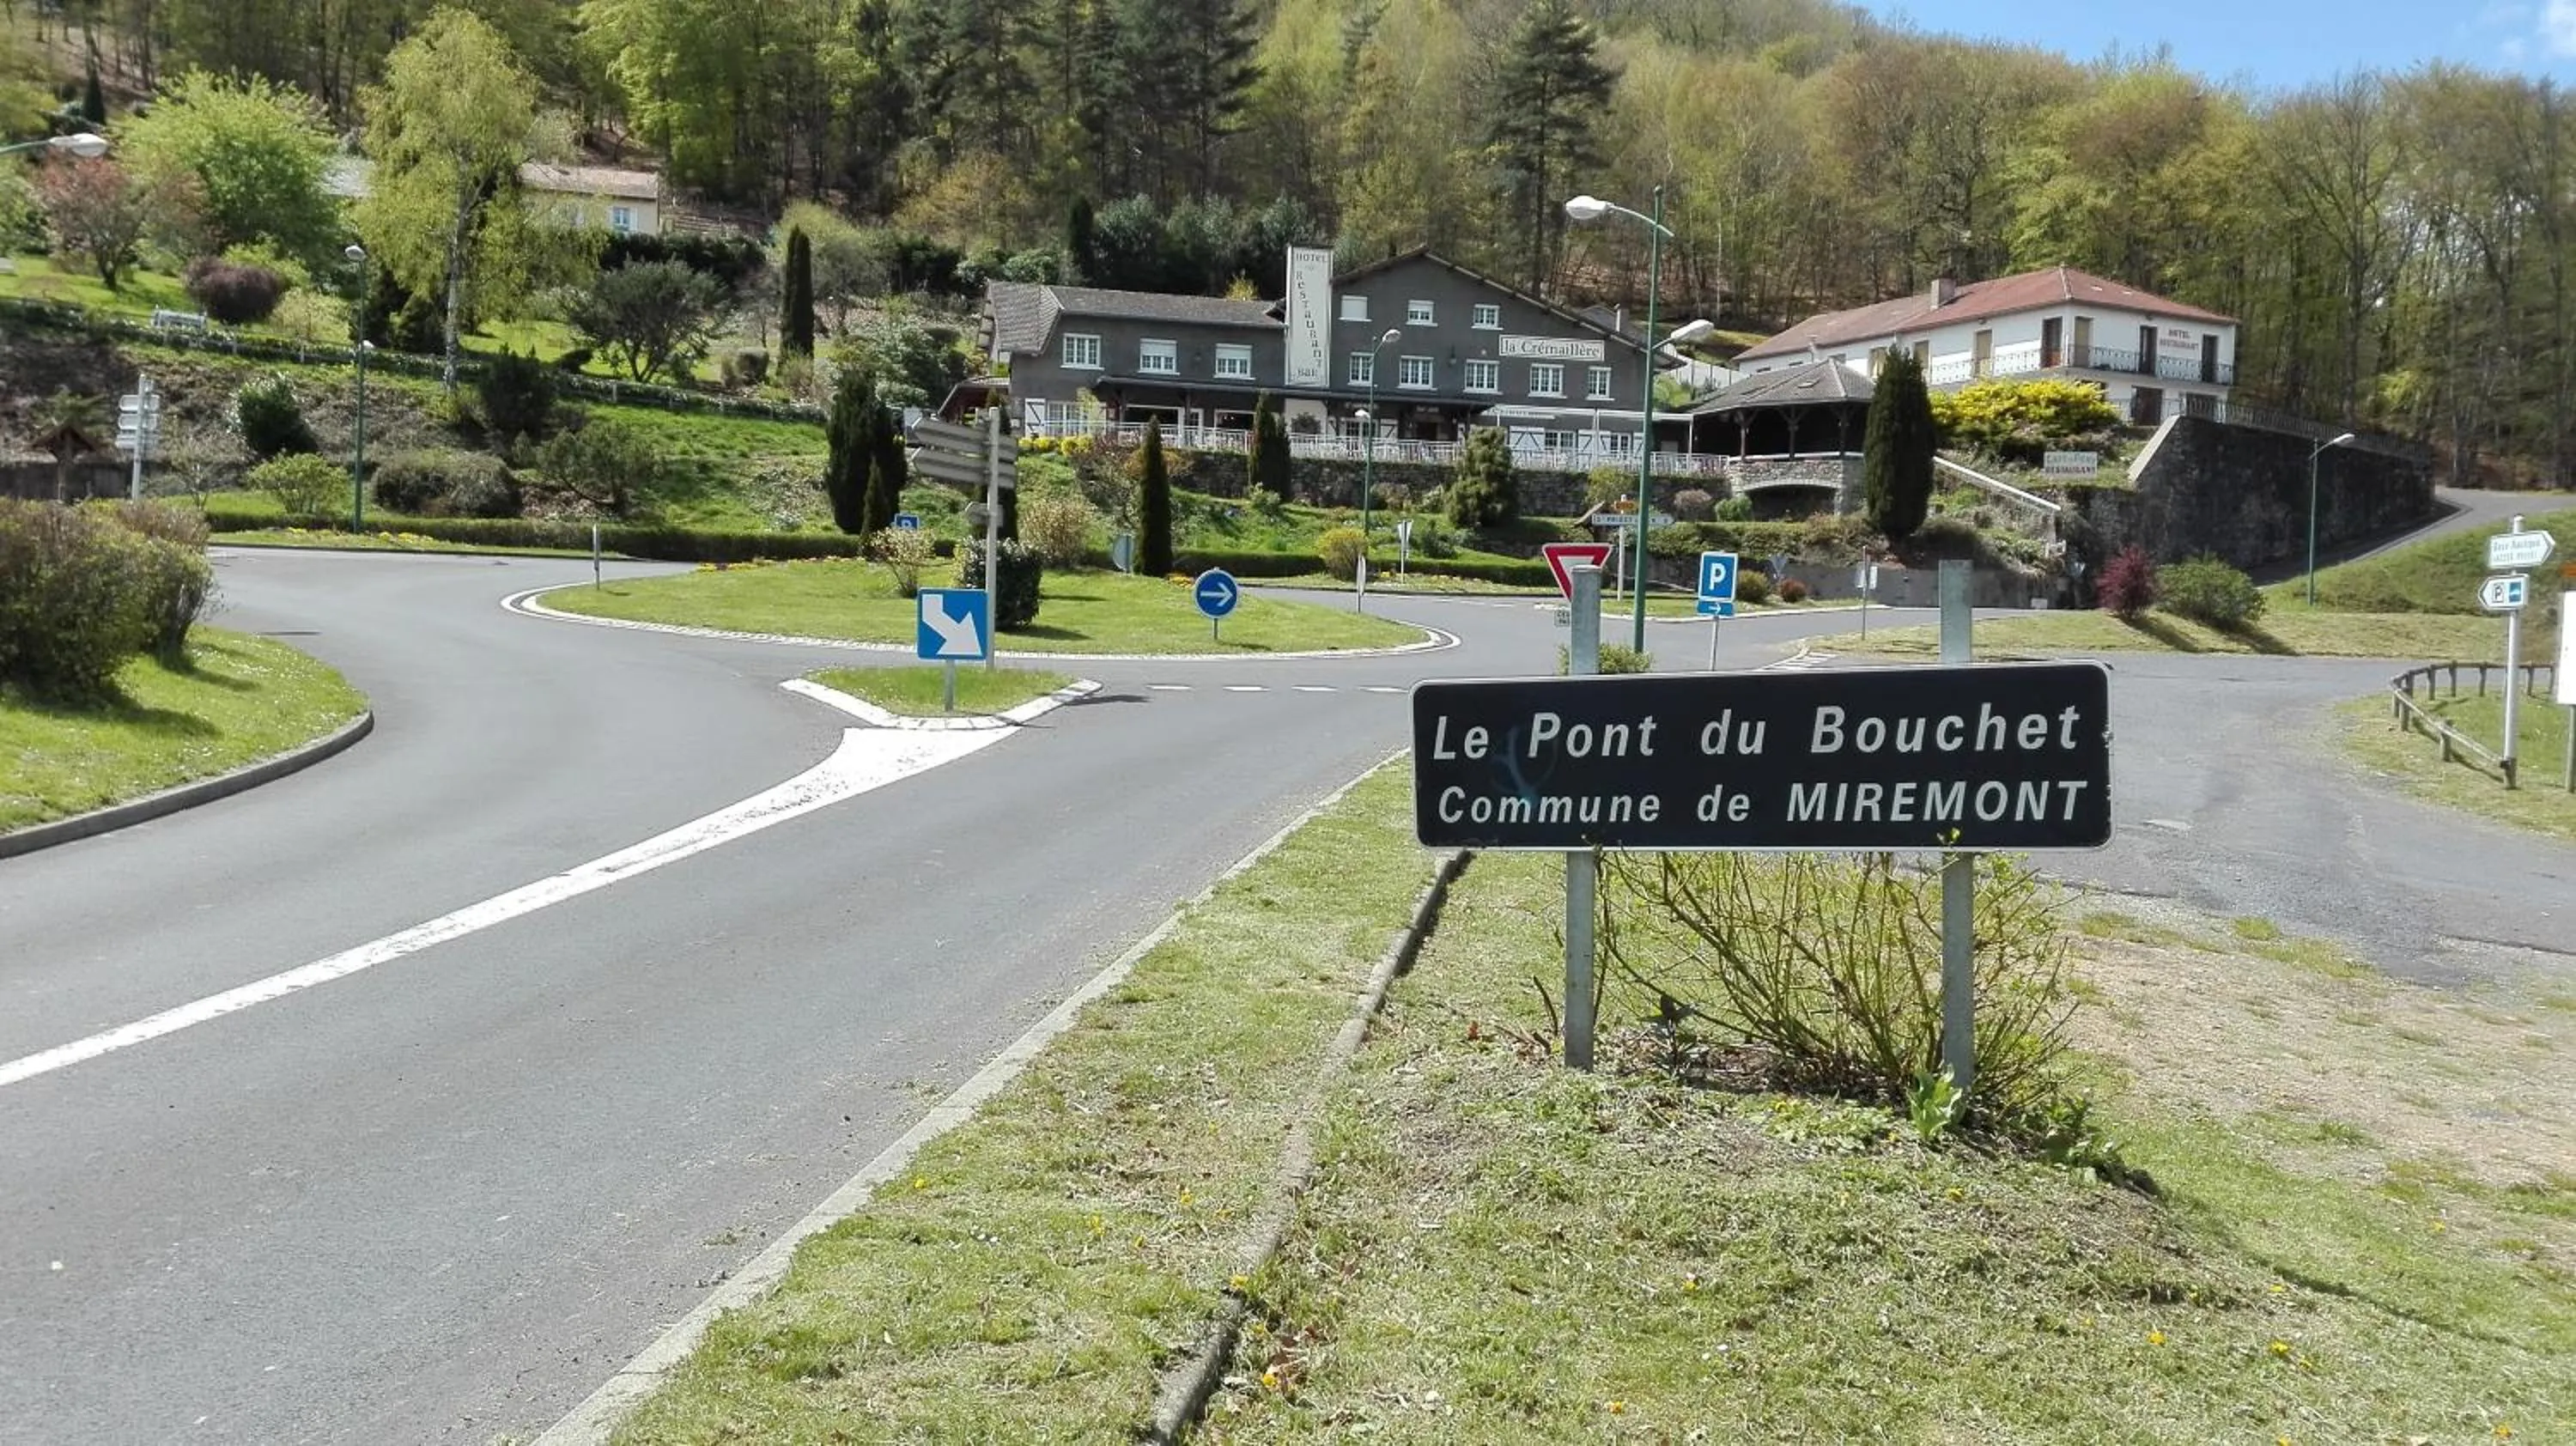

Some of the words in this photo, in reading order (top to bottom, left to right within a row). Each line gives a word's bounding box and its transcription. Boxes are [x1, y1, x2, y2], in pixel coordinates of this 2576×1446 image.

[1296, 253, 1327, 262] HOTEL
[1505, 339, 1516, 352] la
[1521, 341, 1600, 356] Crémaillère
[1709, 562, 1726, 590] P
[1433, 715, 1489, 760] Le
[1528, 712, 1656, 757] Pont
[1701, 708, 1766, 756] du
[1811, 702, 2081, 754] Bouchet
[1438, 786, 1661, 824] Commune
[1698, 784, 1751, 822] de
[1787, 780, 2089, 823] MIREMONT
